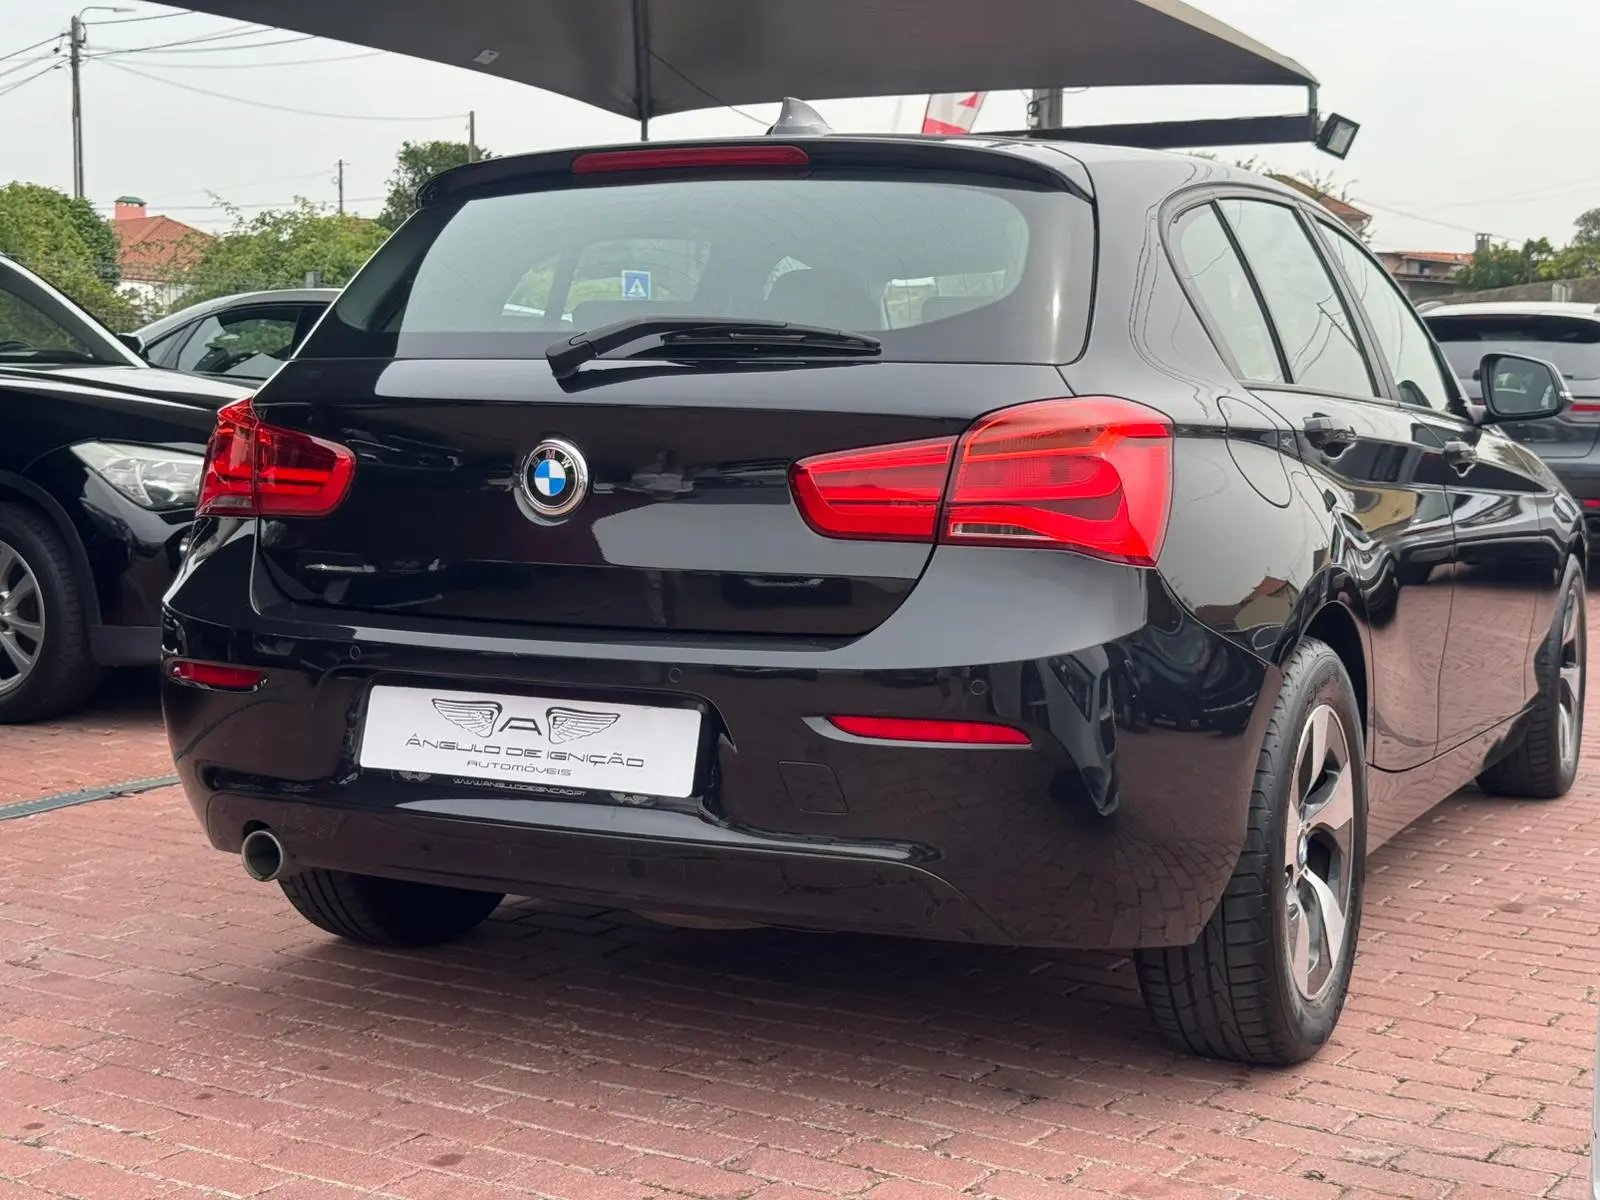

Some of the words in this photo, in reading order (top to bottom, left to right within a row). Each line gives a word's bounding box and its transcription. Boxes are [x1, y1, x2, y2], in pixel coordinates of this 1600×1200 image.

[530, 449, 573, 469] BMW
[498, 716, 542, 736] A
[405, 733, 500, 754] ÂNGULO
[506, 747, 542, 759] DE
[547, 751, 644, 768] IGNIÇÃO
[467, 760, 572, 776] AUTOMÓVEIS
